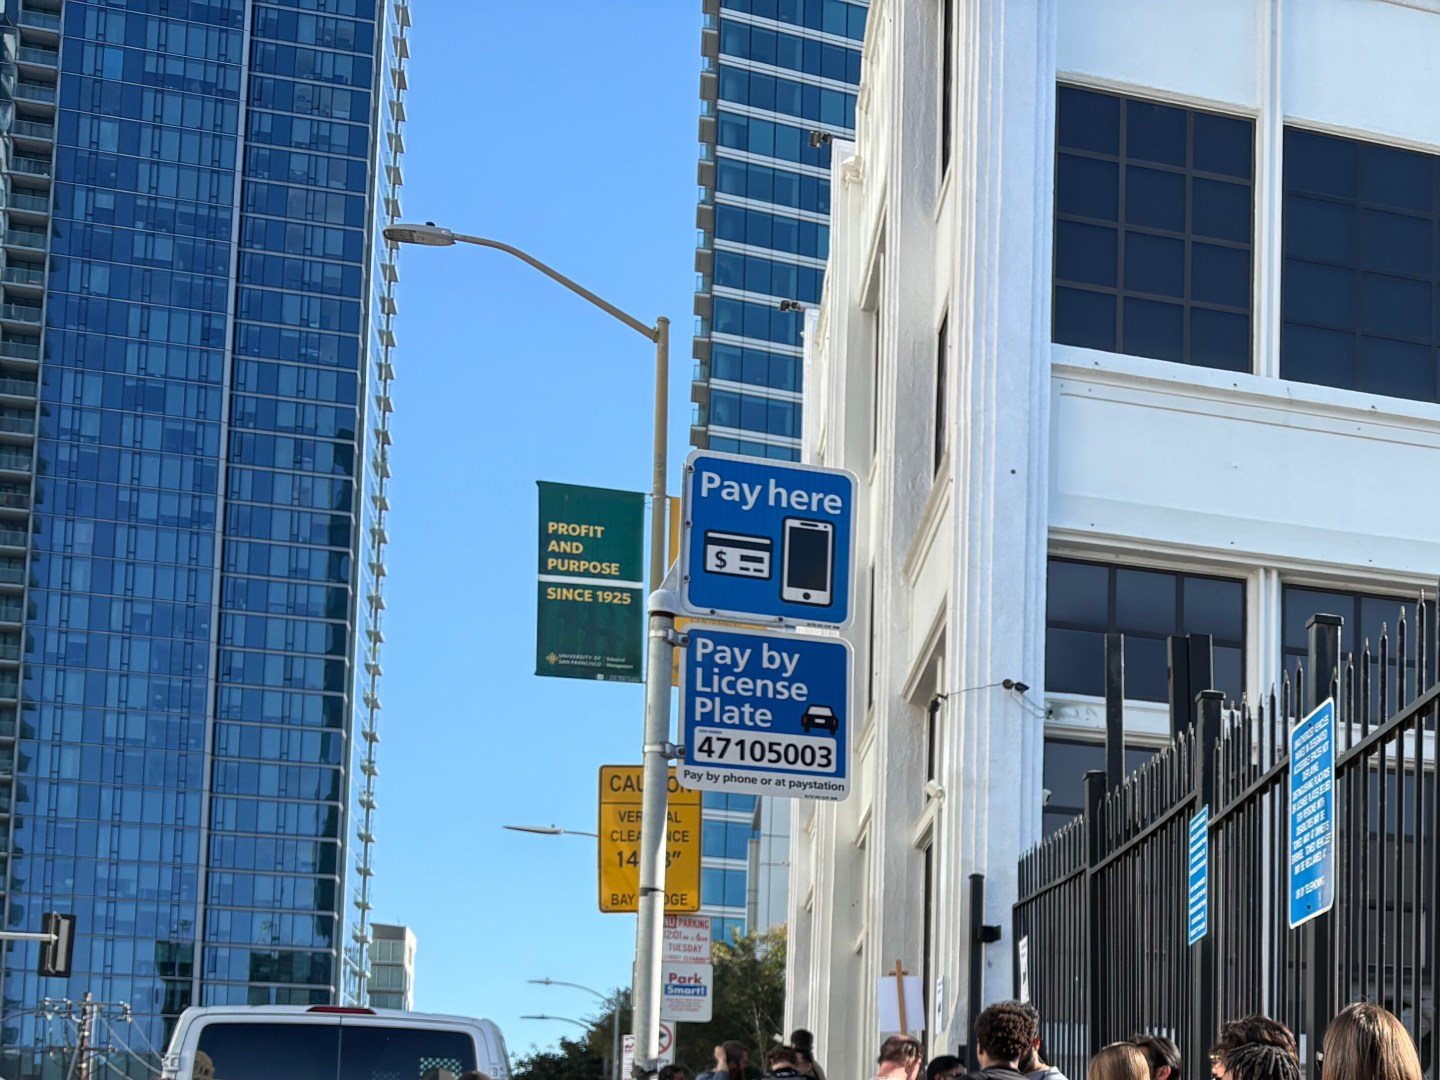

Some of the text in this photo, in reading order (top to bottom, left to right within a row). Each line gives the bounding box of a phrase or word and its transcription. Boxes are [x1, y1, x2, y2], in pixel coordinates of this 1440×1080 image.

[701, 471, 843, 515] Pay here
[548, 521, 605, 539] PROFIT
[547, 539, 584, 554] AND
[547, 558, 620, 575] PURPOSE
[547, 587, 631, 605] SINCE 1925
[696, 637, 800, 678] Pay by
[696, 667, 809, 702] License
[695, 696, 773, 727] Plate
[698, 736, 833, 769] 47105003
[684, 769, 845, 792] Pay by phone or at paystation
[611, 892, 635, 906] BAY
[678, 917, 709, 930] PARKING
[668, 942, 702, 953] TUESDAY
[669, 972, 703, 985] Park
[667, 985, 705, 996] Smart!
